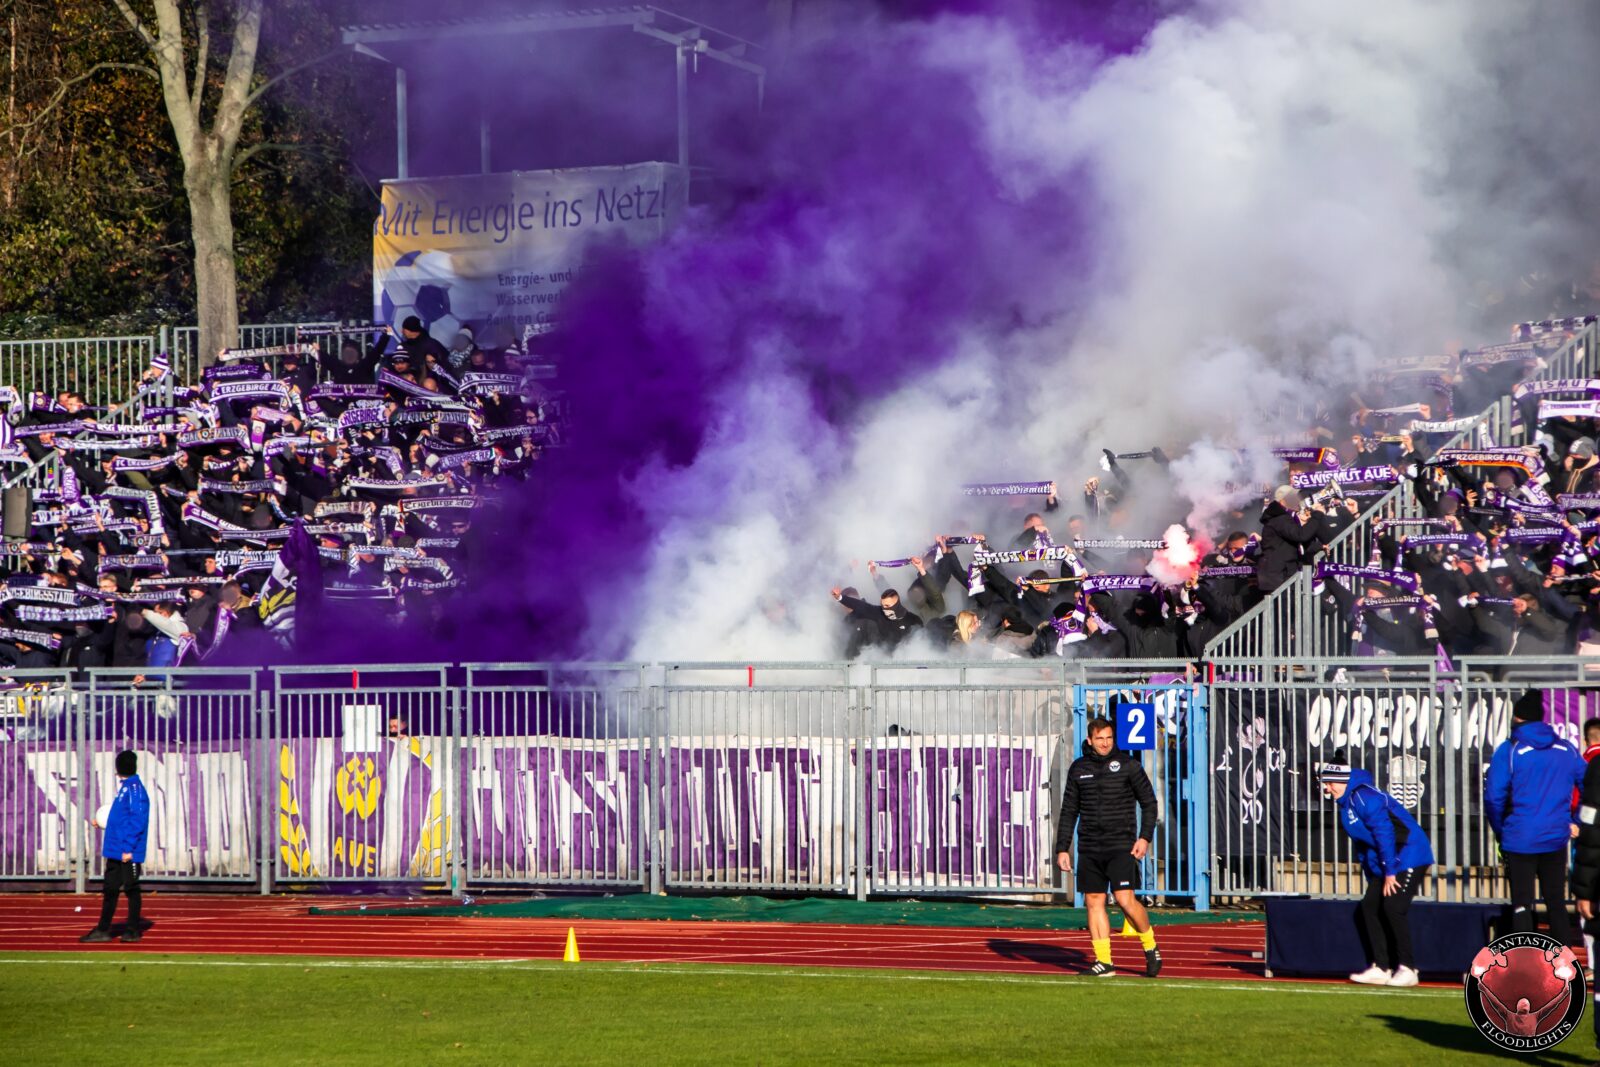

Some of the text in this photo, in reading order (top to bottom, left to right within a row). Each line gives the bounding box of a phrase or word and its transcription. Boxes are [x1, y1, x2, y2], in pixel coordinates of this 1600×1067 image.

[374, 181, 668, 243] Mit Energie ins Netz!
[497, 267, 573, 288] Energie- und
[1524, 379, 1593, 394] WISMUT
[1309, 470, 1362, 485] WISMUT
[1363, 467, 1392, 480] AUE
[1324, 563, 1414, 584] FC Erzgebirge Aue
[1127, 708, 1147, 745] 2
[333, 835, 377, 873] AUE
